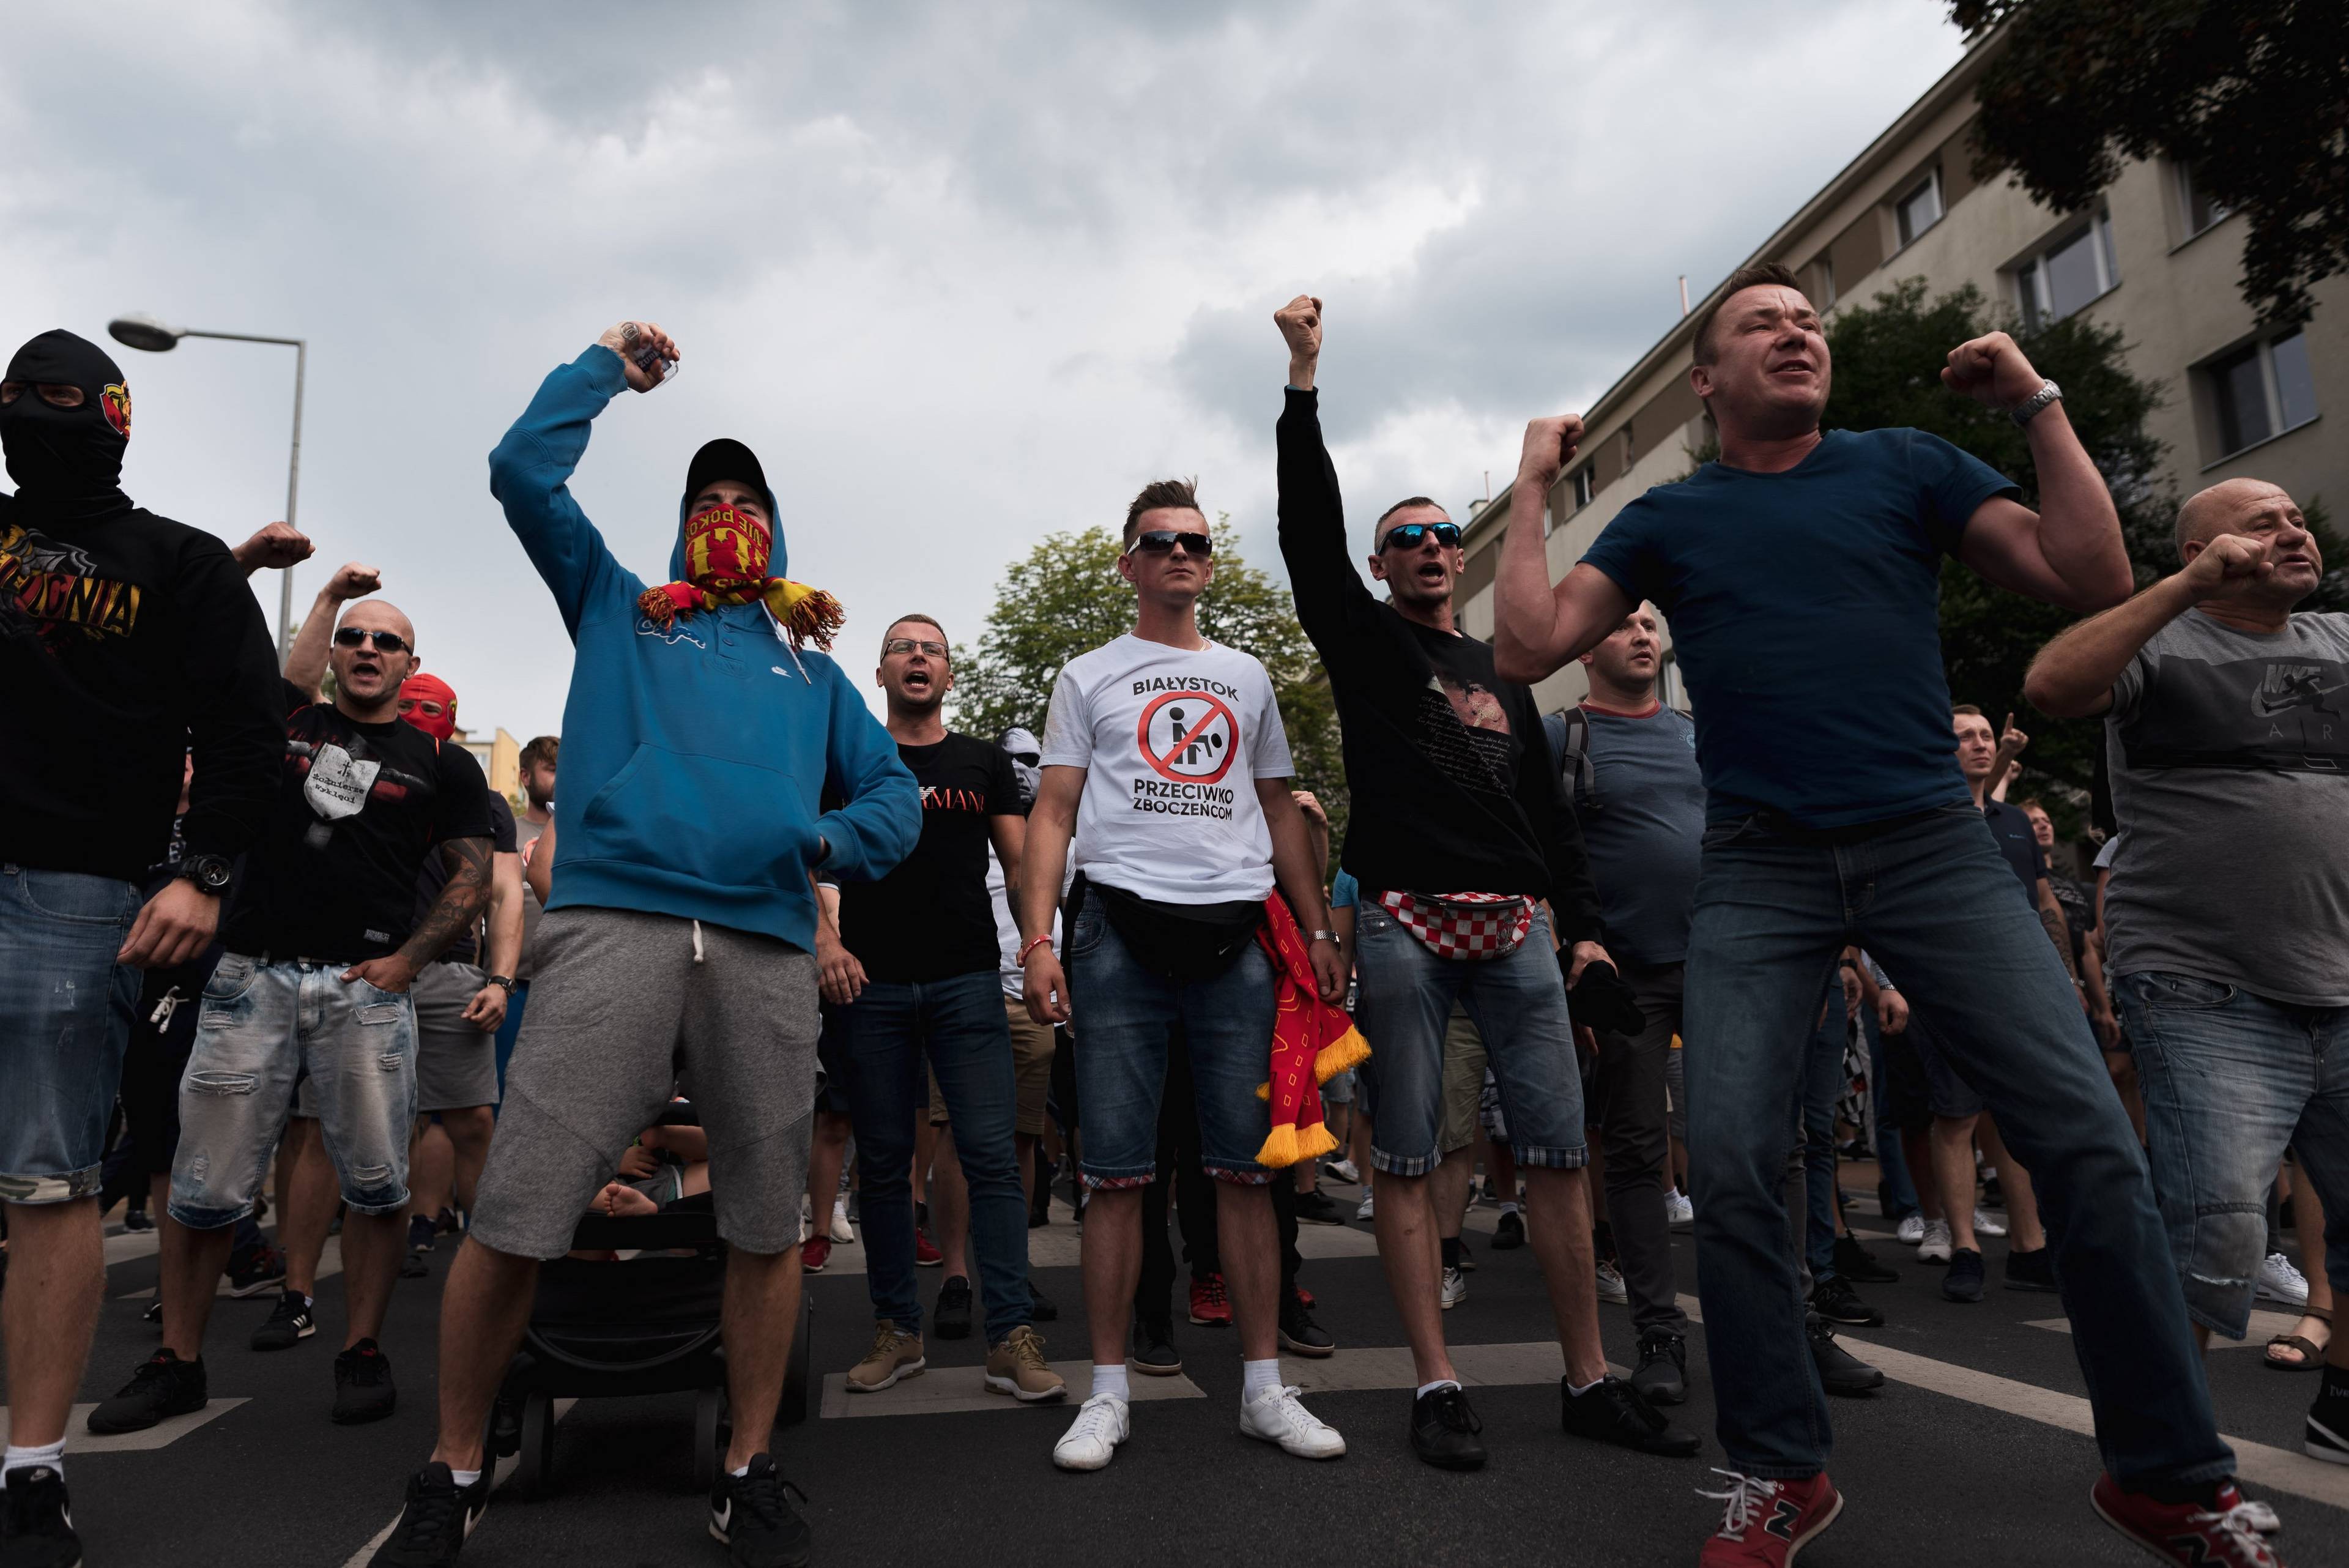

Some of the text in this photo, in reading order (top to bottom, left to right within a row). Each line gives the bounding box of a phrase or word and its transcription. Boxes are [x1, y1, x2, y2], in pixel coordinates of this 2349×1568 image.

[1133, 677, 1239, 702] BIAŁYSTOK
[2263, 664, 2321, 694] NIKE
[2269, 723, 2332, 740] AR
[1134, 779, 1234, 804] PRZECIWKO
[1133, 797, 1233, 820] ZBOCZEŃCOM
